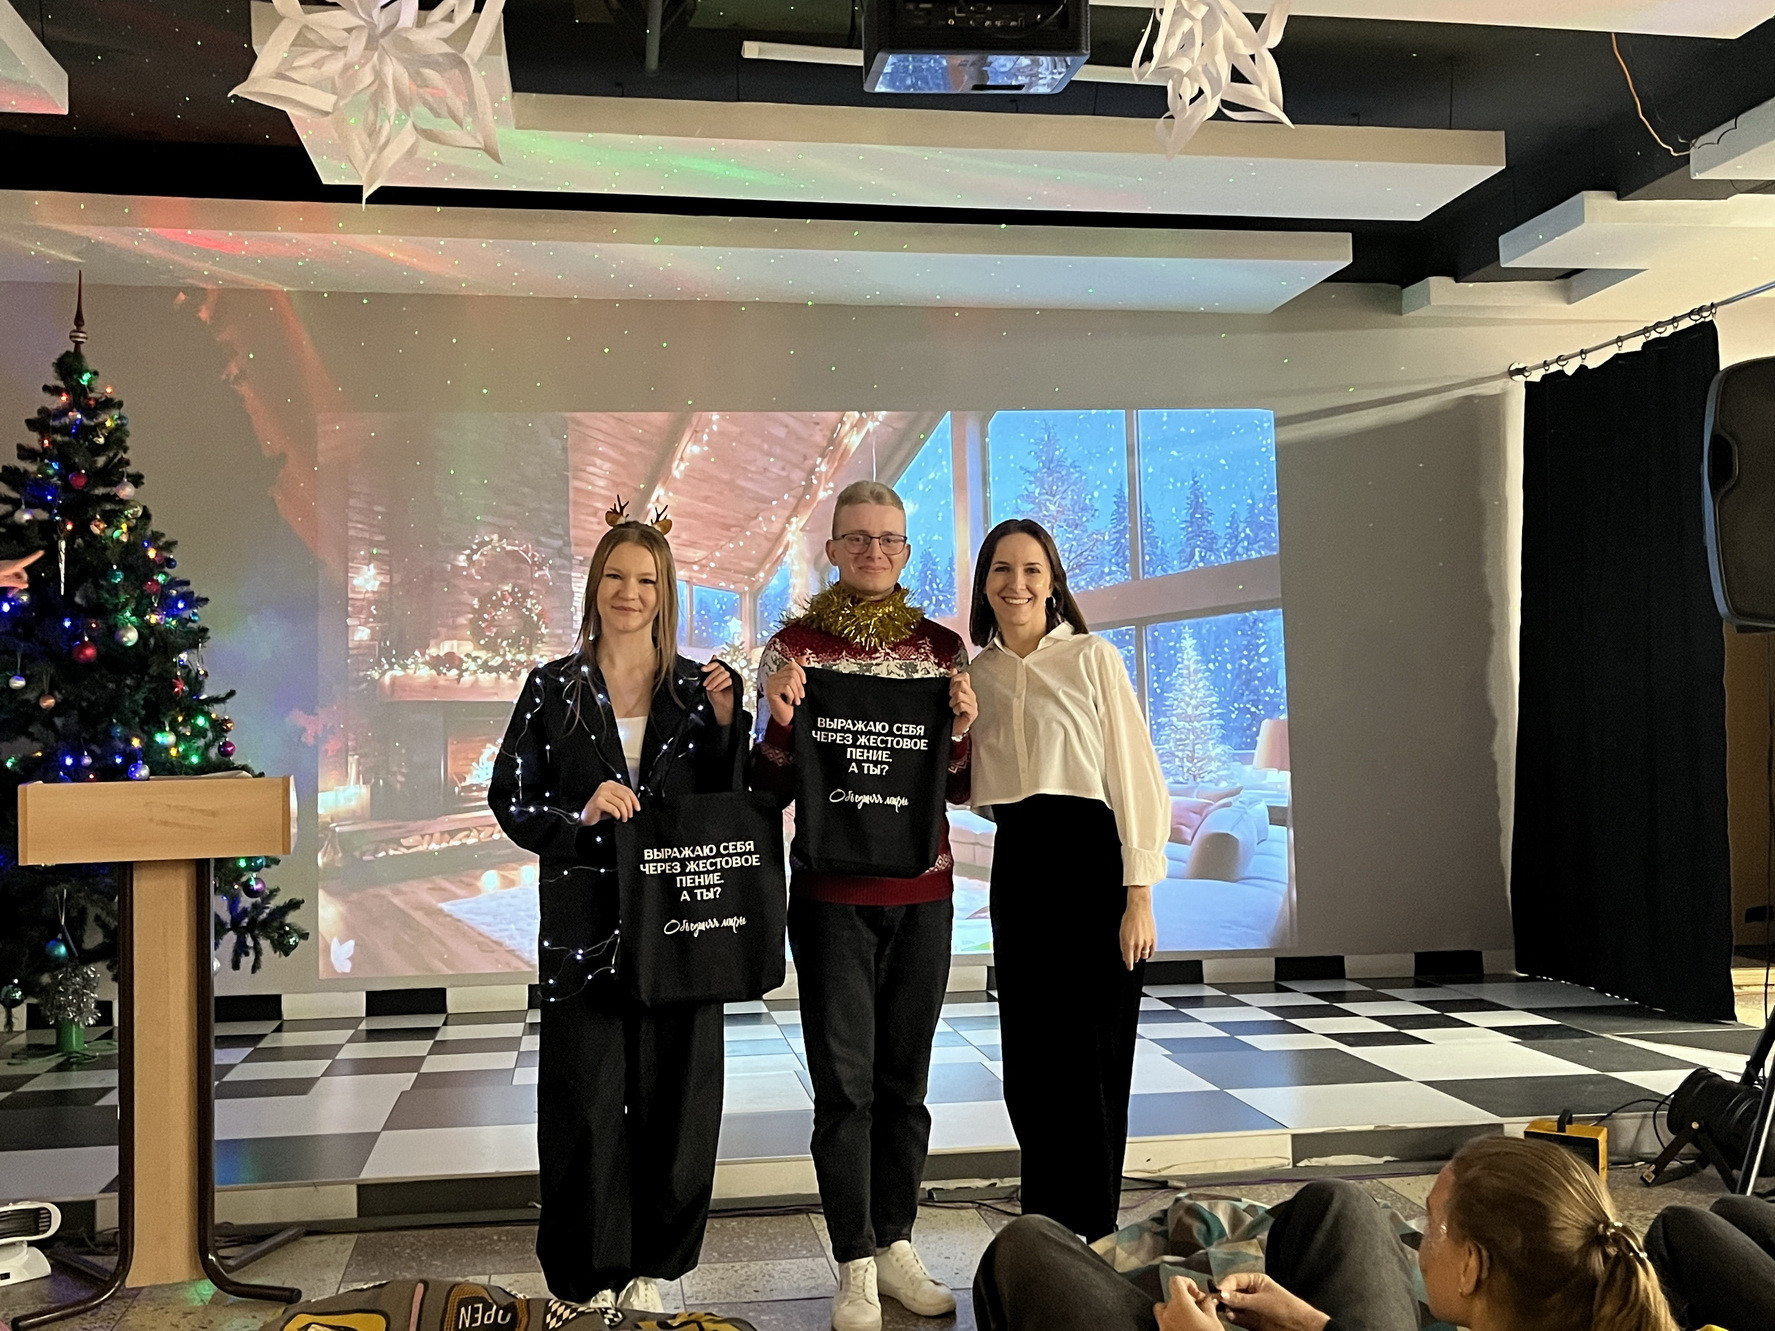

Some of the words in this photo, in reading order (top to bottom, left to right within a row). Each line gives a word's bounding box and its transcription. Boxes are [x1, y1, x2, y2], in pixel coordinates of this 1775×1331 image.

[817, 717, 889, 733] ВЫРАЖАЮ
[893, 723, 924, 736] СЕБЯ
[812, 730, 852, 744] ЧЕРЕЗ
[856, 734, 928, 750] ЖЕСТОВОЕ
[847, 748, 892, 762] ПЕНИЕ.
[848, 762, 858, 773] А
[861, 763, 889, 776] ТЫ?
[644, 844, 716, 860] ВЫРАЖАЮ
[720, 840, 754, 854] СЕБЯ
[640, 862, 681, 874] ЧЕРЕЗ
[685, 854, 760, 872] ЖЕСТОВОЕ
[676, 872, 724, 887] ПЕНИЕ.
[680, 890, 690, 901] А
[694, 887, 721, 900] ТЫ?
